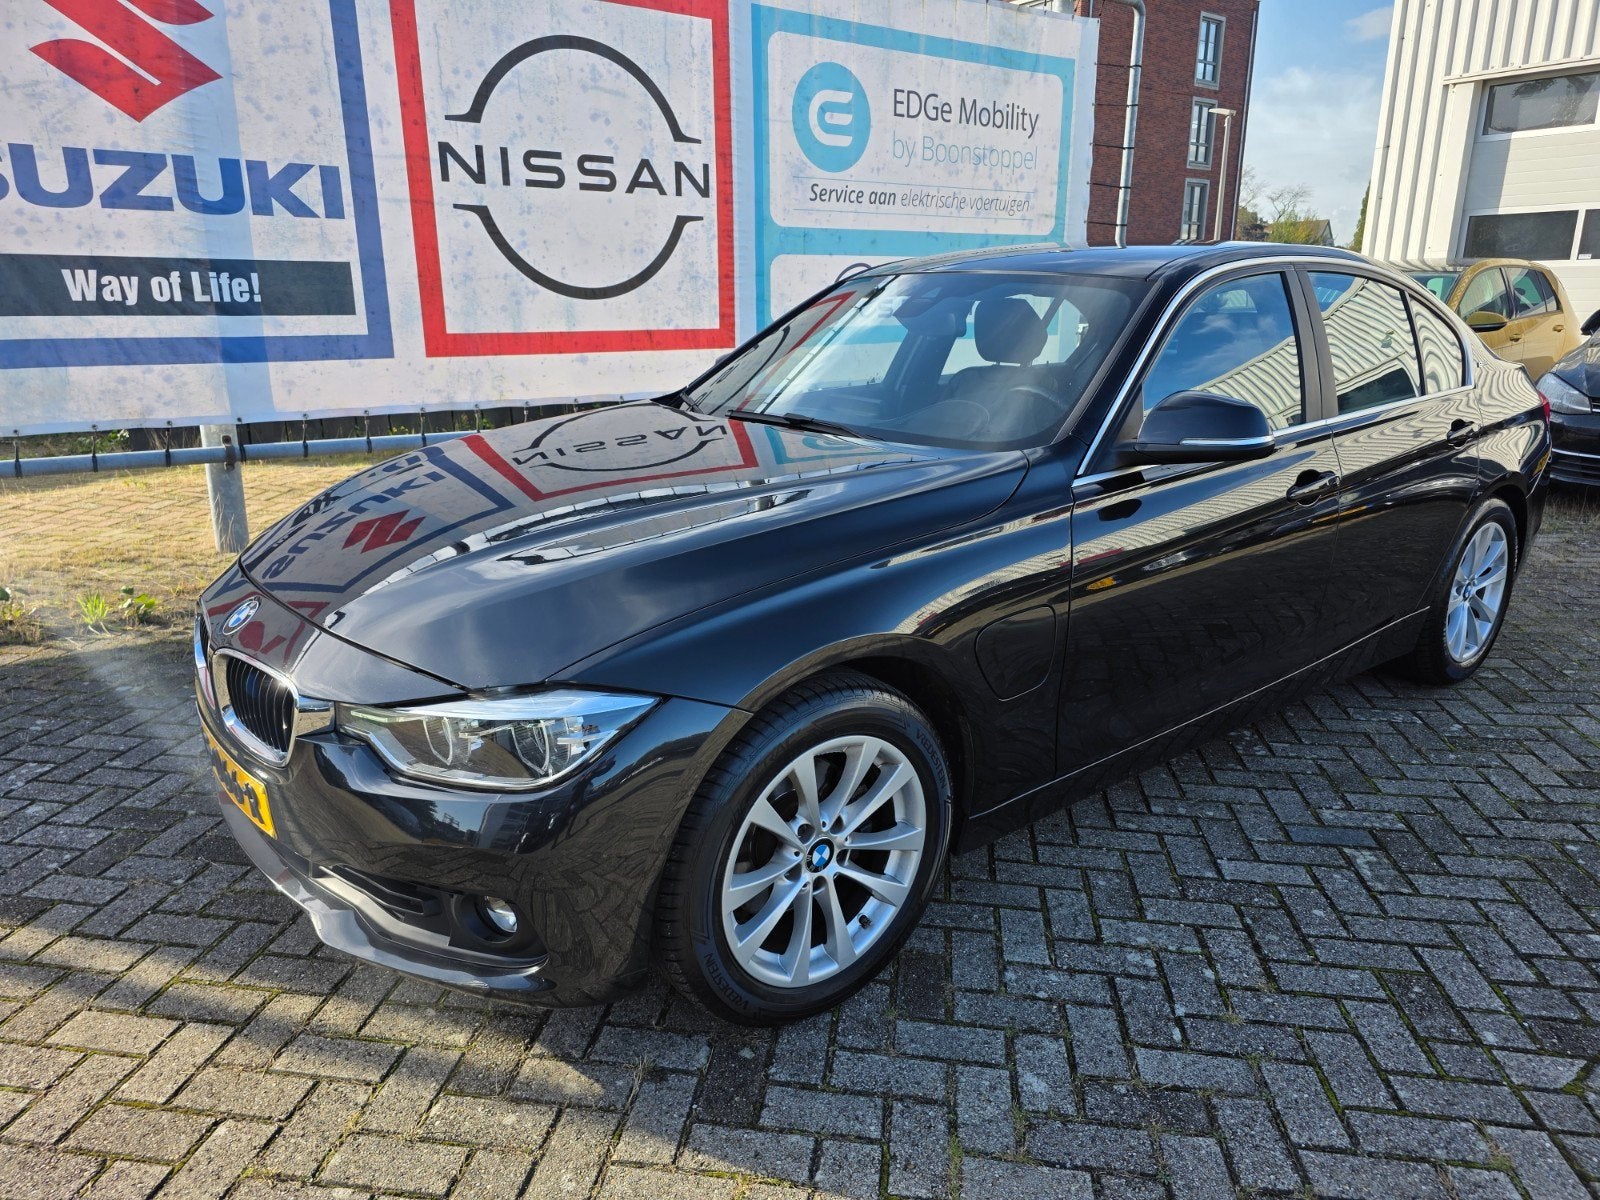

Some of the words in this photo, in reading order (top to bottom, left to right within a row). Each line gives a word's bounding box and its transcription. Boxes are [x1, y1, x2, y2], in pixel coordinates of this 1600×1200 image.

[892, 88, 952, 123] EDGe
[958, 97, 1040, 139] Mobility
[437, 141, 710, 199] NISSAN
[892, 131, 915, 167] by
[921, 135, 1038, 175] Boonstoppel
[0, 142, 346, 220] UZUKI
[808, 183, 864, 205] Service
[868, 189, 896, 206] aan
[900, 189, 967, 210] elektrische
[969, 196, 1030, 217] voertuigen
[61, 268, 139, 305] Way
[150, 271, 182, 302] of
[190, 271, 262, 303] Life!
